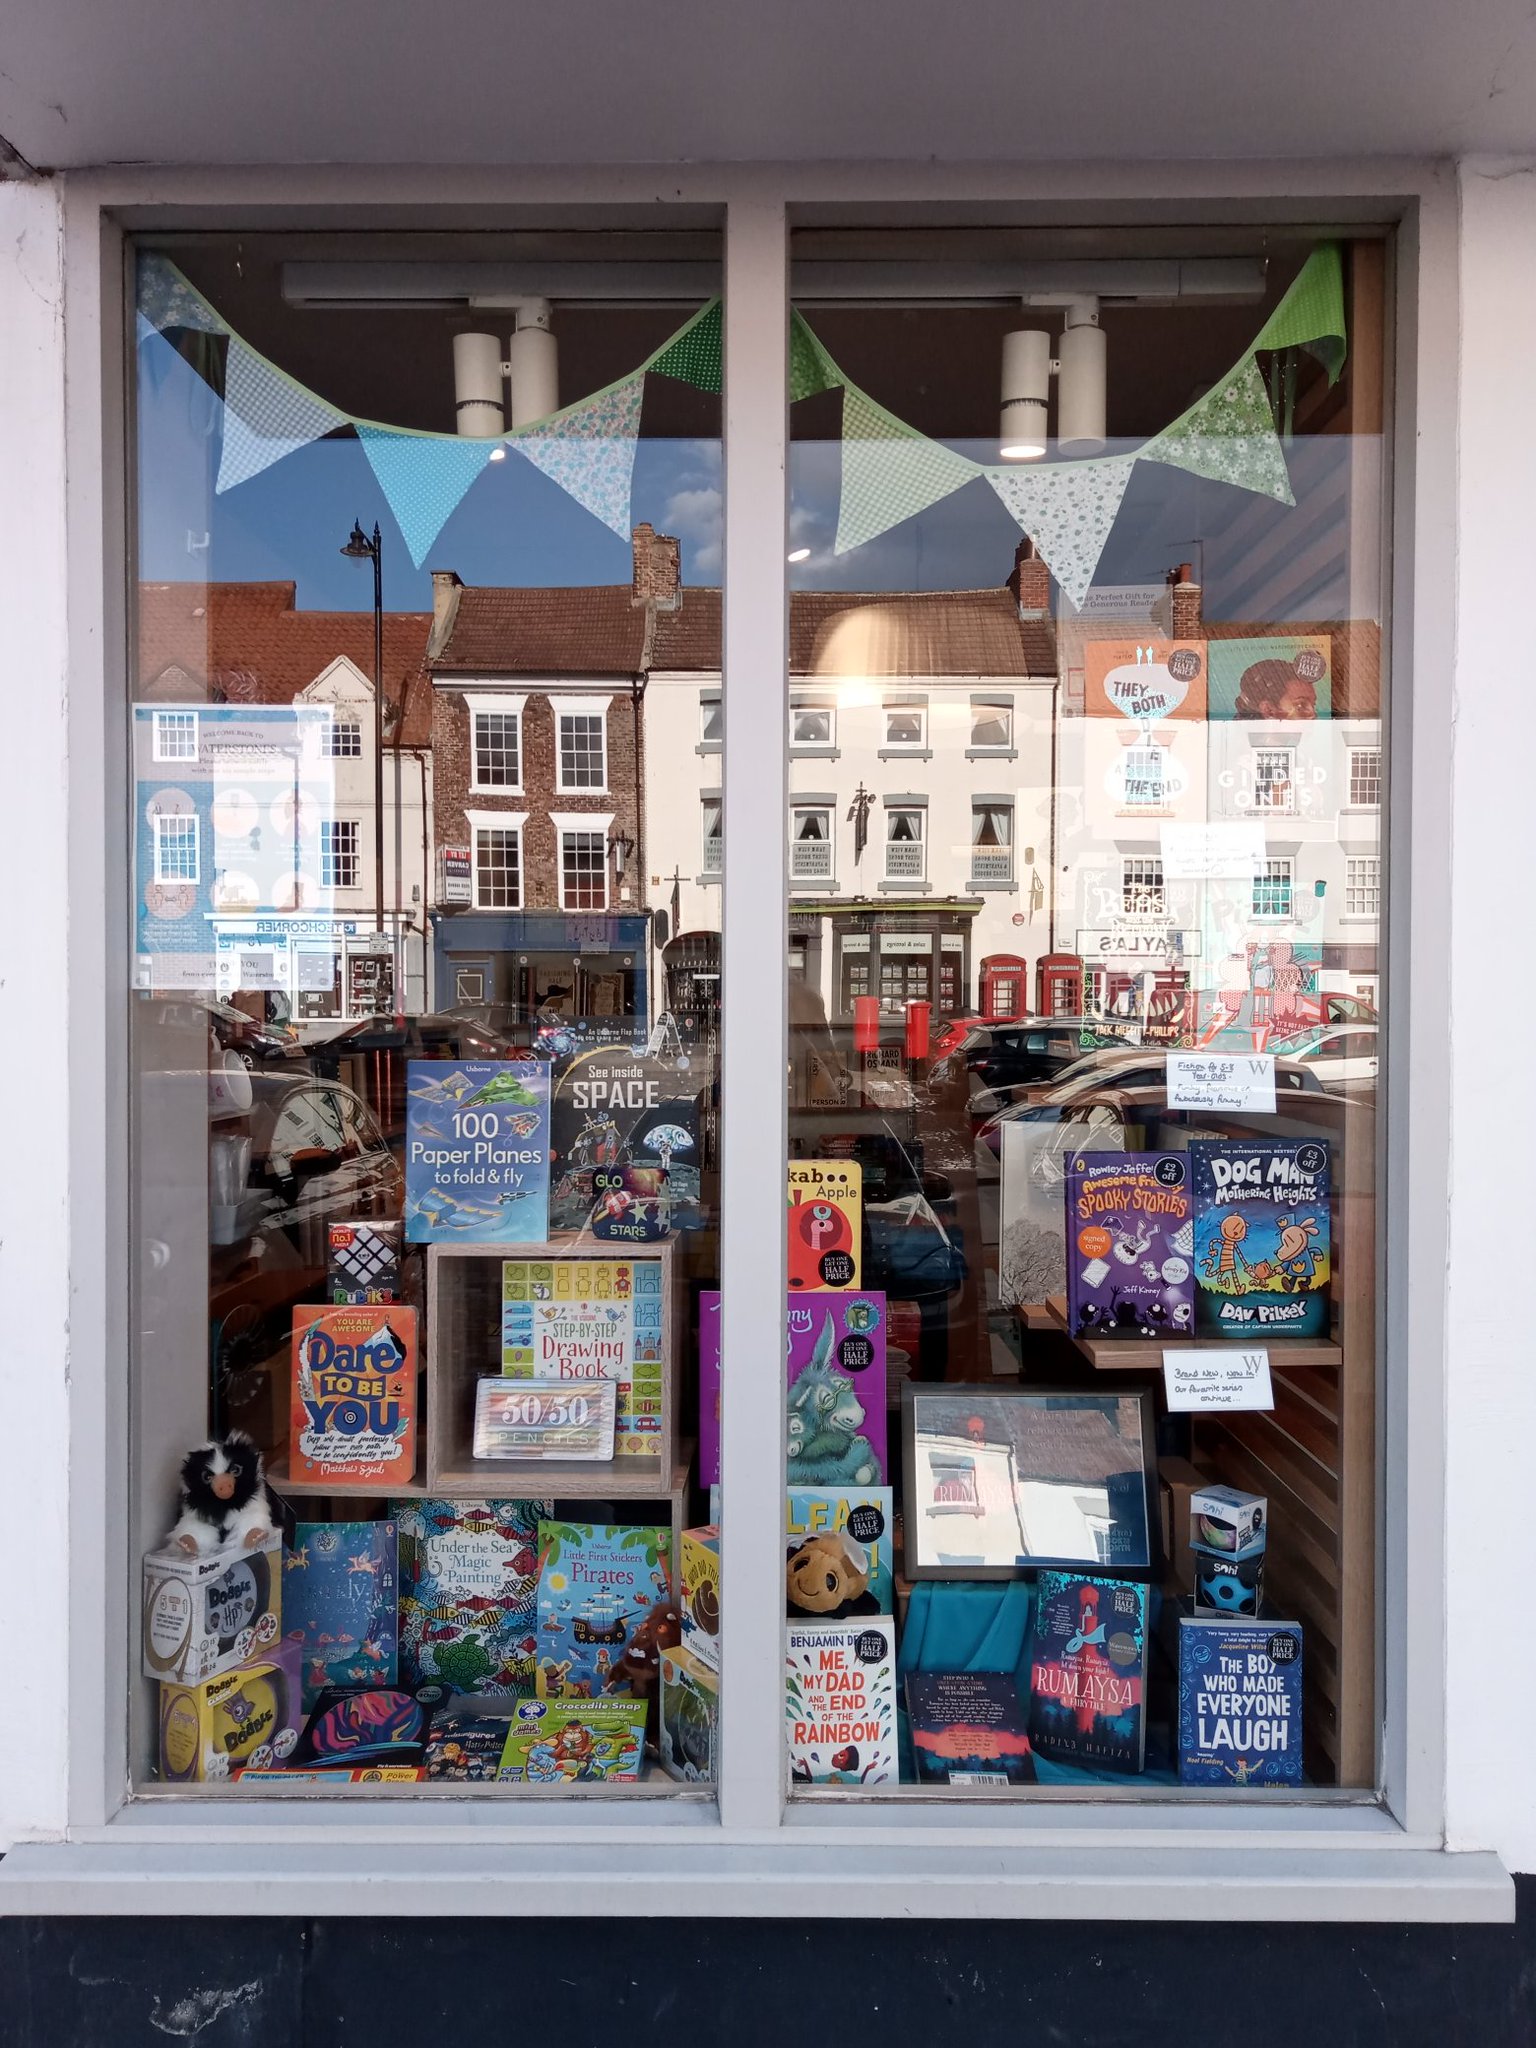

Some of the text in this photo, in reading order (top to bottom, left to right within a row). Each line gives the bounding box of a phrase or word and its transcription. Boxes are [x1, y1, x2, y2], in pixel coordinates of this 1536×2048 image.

[1125, 592, 1141, 600] Gift
[1113, 681, 1149, 698] THEY
[1131, 694, 1167, 715] BOTH
[191, 744, 277, 754] WATERSTONES
[621, 1028, 632, 1036] Flap
[633, 1028, 647, 1036] Book
[866, 1050, 900, 1059] RICHARD
[465, 1064, 491, 1073] Usborne
[588, 1065, 644, 1078] See inside
[1248, 1060, 1269, 1076] W
[573, 1080, 660, 1109] SPACE
[451, 1112, 499, 1139] 100
[410, 1142, 542, 1170] Paper Planes
[1306, 1149, 1319, 1160] £3
[1164, 1162, 1176, 1172] £2
[1302, 1159, 1318, 1169] off
[434, 1168, 524, 1187] to fold & fly
[1088, 1165, 1122, 1178] Rowley
[1162, 1172, 1177, 1181] off
[1210, 1157, 1315, 1188] DOG MAN
[595, 1174, 623, 1188] GLO
[1082, 1176, 1137, 1194] Awesome
[816, 1185, 857, 1200] Apple
[1077, 1188, 1187, 1219] SPOOKY STORIES
[610, 1224, 646, 1237] STARS
[1083, 1235, 1106, 1244] signed
[1085, 1243, 1102, 1253] copy
[825, 1266, 850, 1274] HALF
[825, 1272, 850, 1280] PRICE
[333, 1286, 393, 1305] Rubik's
[1123, 1286, 1161, 1298] Jeff Kinney
[1219, 1302, 1254, 1322] DAV
[553, 1322, 617, 1338] STEP-BY-STEP
[301, 1330, 404, 1375] Dare
[543, 1335, 624, 1366] Drawing
[844, 1351, 868, 1359] HALF
[844, 1357, 869, 1365] PRICE
[1242, 1355, 1263, 1371] W
[559, 1358, 608, 1380] Book
[1174, 1368, 1243, 1379] Brand Now
[324, 1376, 383, 1396] TO BE
[1221, 1384, 1243, 1392] series
[502, 1394, 589, 1426] 50/50
[304, 1400, 400, 1436] YOU
[499, 1432, 589, 1445] PENCILS
[333, 1451, 377, 1460] confidently
[320, 1462, 385, 1478] Matthew Syed
[854, 1520, 879, 1530] HALF
[855, 1527, 880, 1537] PRICE
[430, 1540, 513, 1553] Under the Sea
[449, 1554, 492, 1571] Magic
[563, 1549, 643, 1563] Little First Stickers
[443, 1570, 501, 1586] Painting
[571, 1561, 634, 1585] Pirates
[1114, 1605, 1135, 1614] PRICE
[1115, 1599, 1134, 1608] HALF
[791, 1635, 844, 1648] BENJAMIN
[861, 1643, 882, 1652] HALF
[1219, 1643, 1249, 1651] Jacqueline
[860, 1649, 883, 1658] PRICE
[819, 1650, 849, 1671] ME,
[1219, 1653, 1277, 1674] THE BOY
[803, 1671, 865, 1692] MY DAD
[1036, 1666, 1133, 1706] RUMAYSA
[1203, 1674, 1285, 1693] WHO MADE
[808, 1695, 825, 1703] AND
[812, 1694, 866, 1711] THE END
[1197, 1693, 1291, 1717] EVERYONE
[554, 1702, 641, 1711] Crocodile Snap
[821, 1712, 854, 1721] OF THE
[517, 1723, 538, 1731] mini
[794, 1721, 880, 1745] RAINBOW
[1198, 1717, 1289, 1752] LAUGH
[1201, 1757, 1225, 1766] Fielding
[386, 1772, 414, 1780] Power
